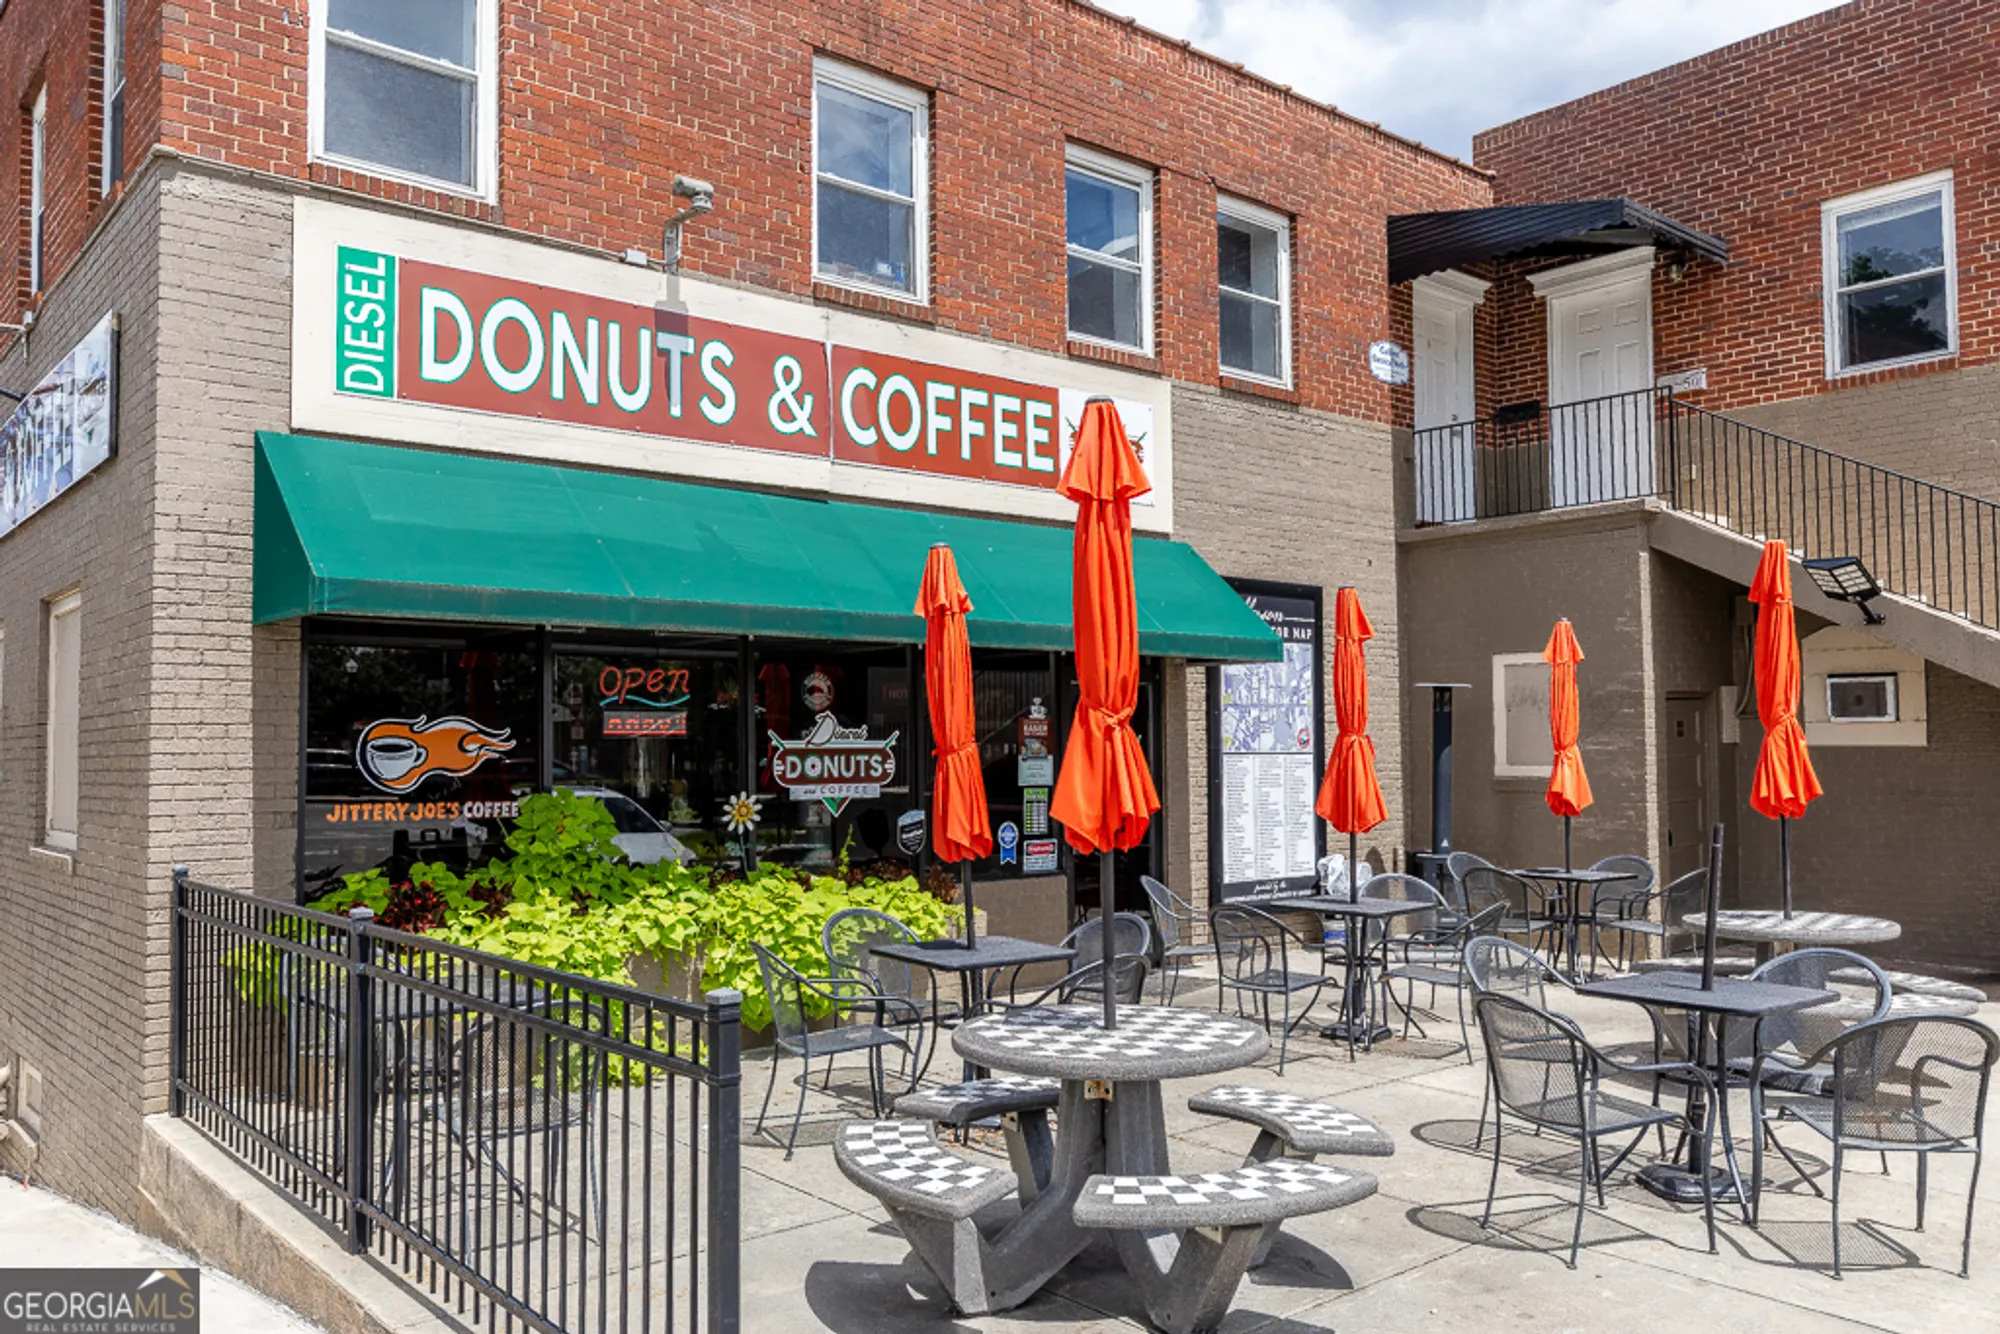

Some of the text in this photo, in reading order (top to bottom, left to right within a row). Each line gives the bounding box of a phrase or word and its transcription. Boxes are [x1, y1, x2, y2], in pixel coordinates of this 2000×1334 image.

[344, 256, 386, 392] DIESEL
[420, 286, 1055, 473] DONUTS & COFFEE
[1292, 626, 1312, 640] MAP
[785, 753, 883, 779] DONUTS
[819, 785, 869, 795] COFFEE
[326, 801, 520, 823] JITTERY JOE'S COFFEE
